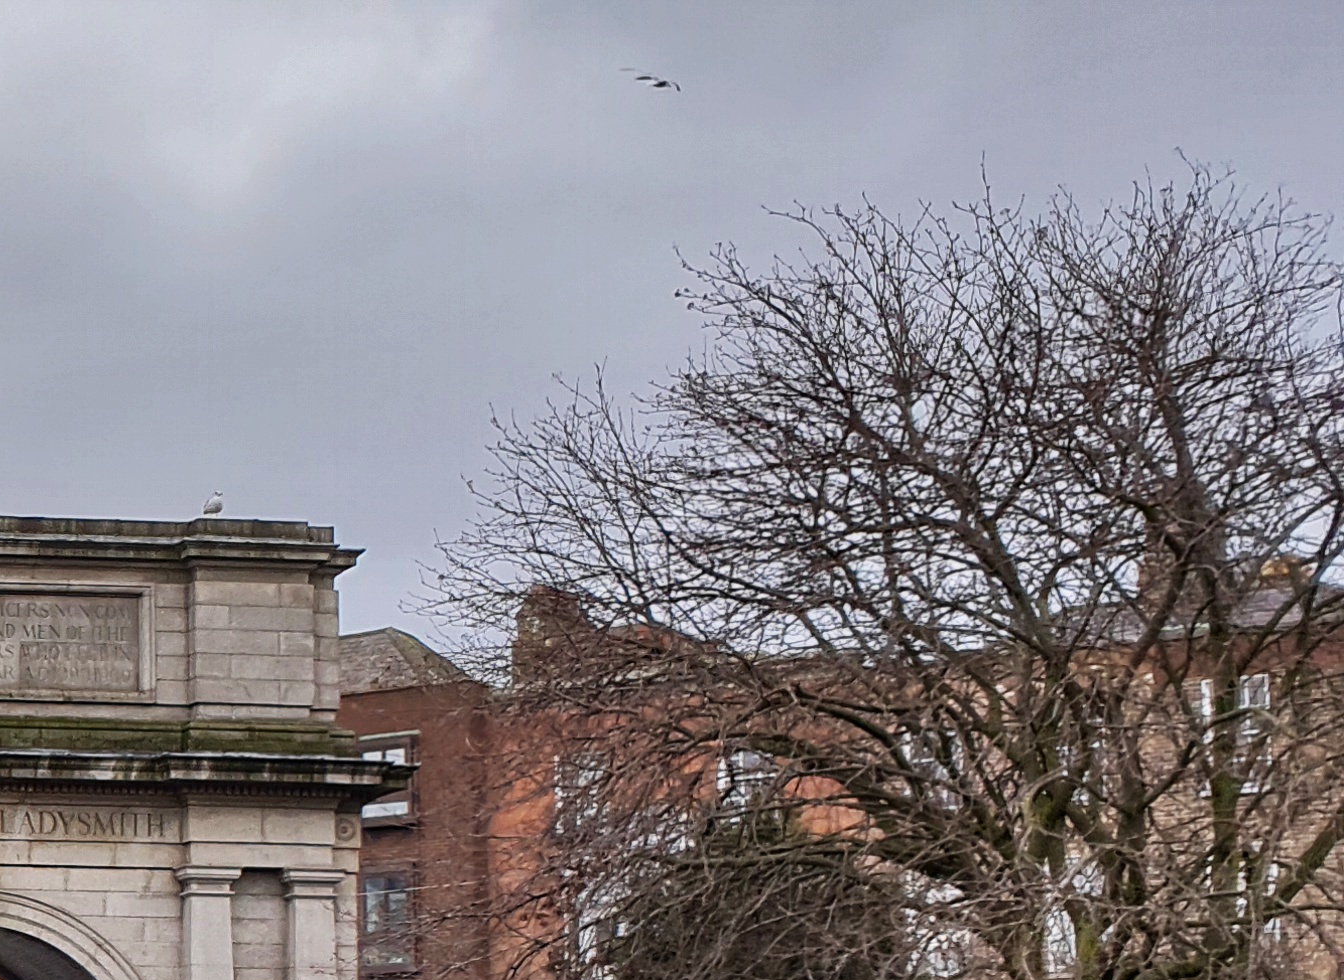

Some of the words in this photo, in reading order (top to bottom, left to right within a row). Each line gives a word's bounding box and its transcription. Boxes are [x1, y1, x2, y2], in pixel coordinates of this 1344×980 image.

[22, 623, 61, 639] MEN
[66, 625, 86, 640] OF
[91, 625, 129, 642] THE
[0, 807, 165, 838] LADYSMITH
